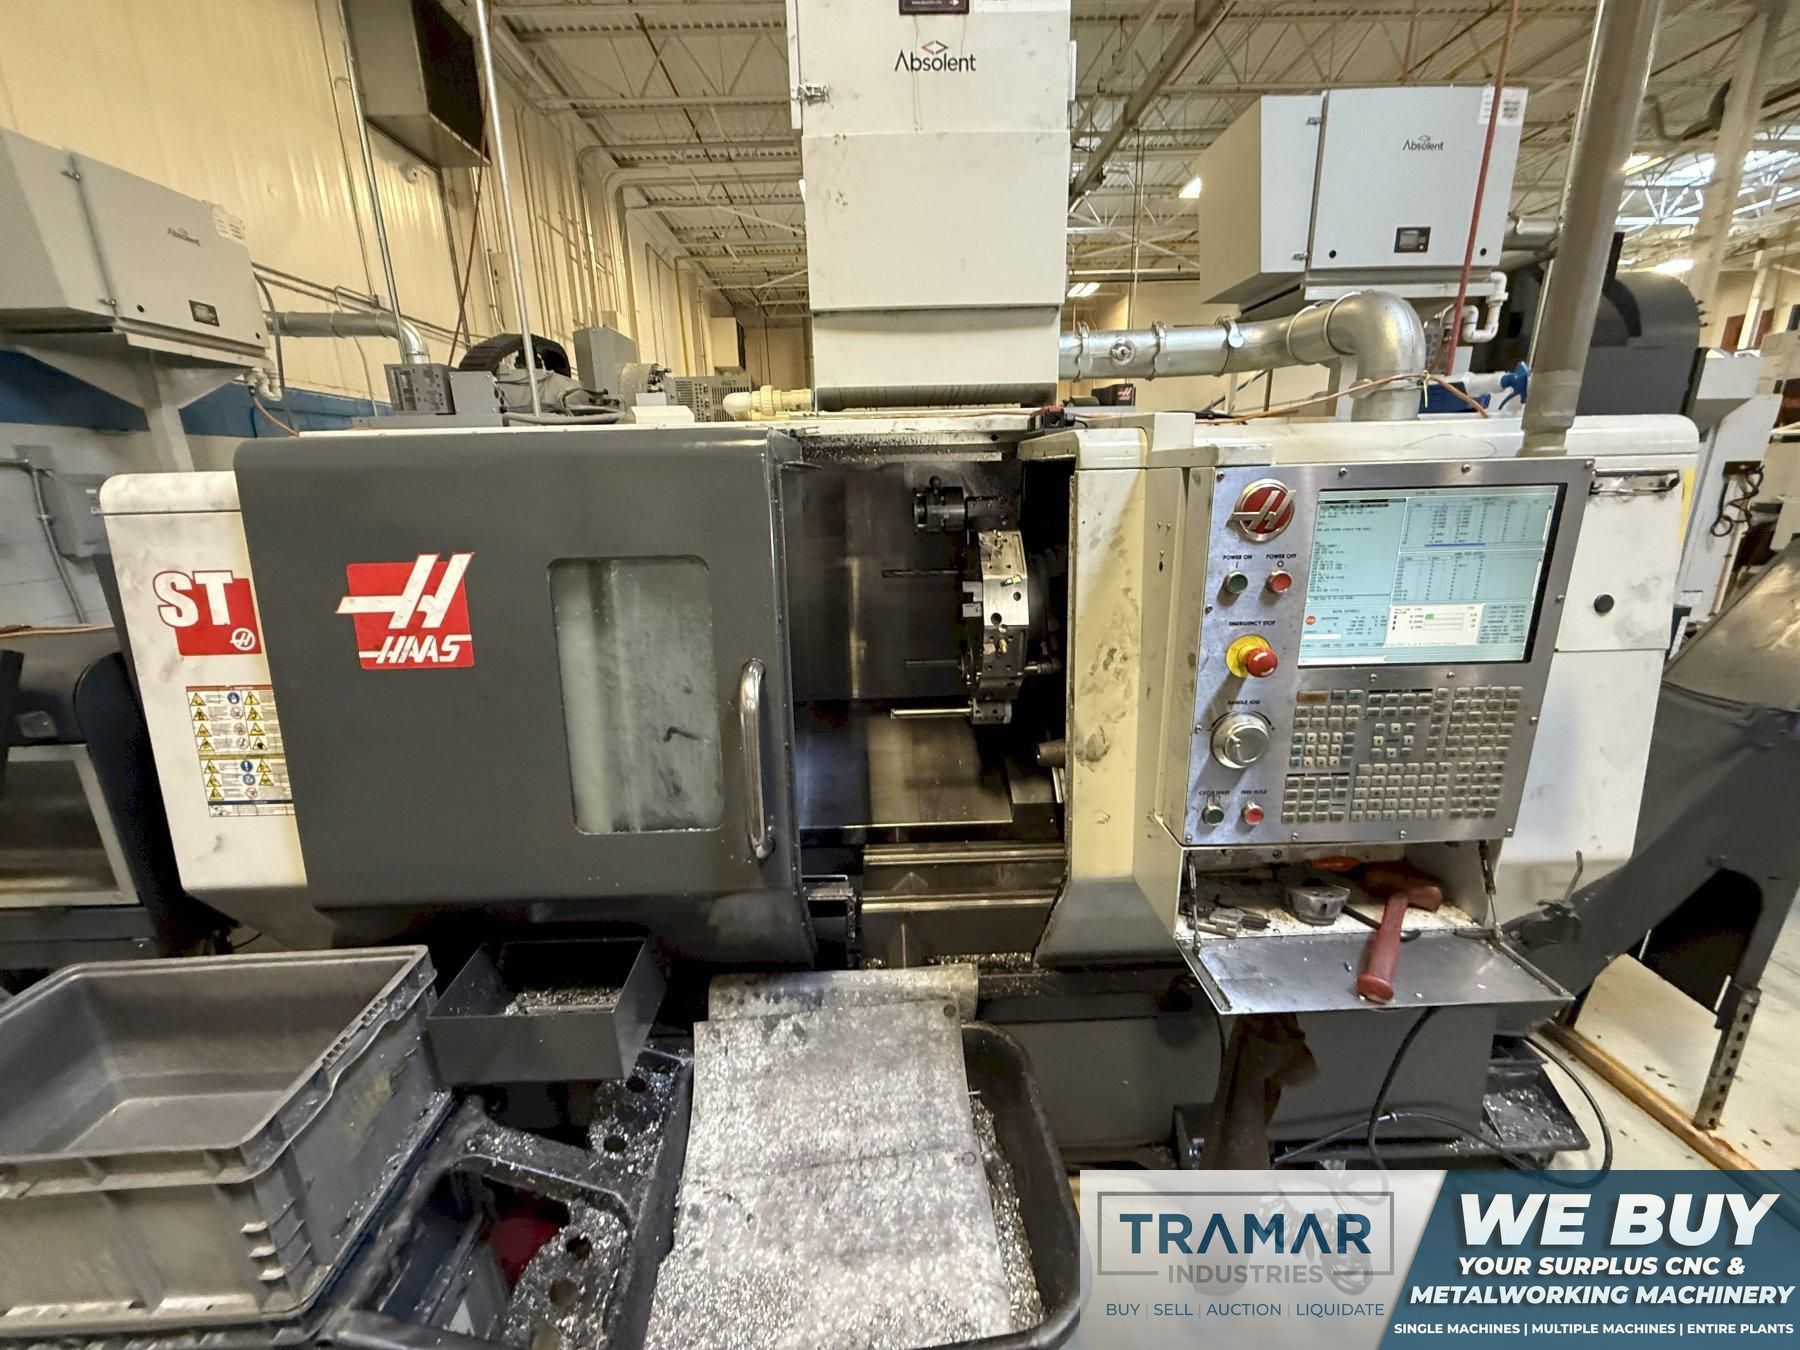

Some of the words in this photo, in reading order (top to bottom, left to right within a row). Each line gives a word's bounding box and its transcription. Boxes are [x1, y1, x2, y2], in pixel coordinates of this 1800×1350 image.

[894, 49, 976, 72] Absolent
[1402, 138, 1444, 151] Absolent
[152, 570, 234, 628] ST
[359, 634, 472, 664] HAAS
